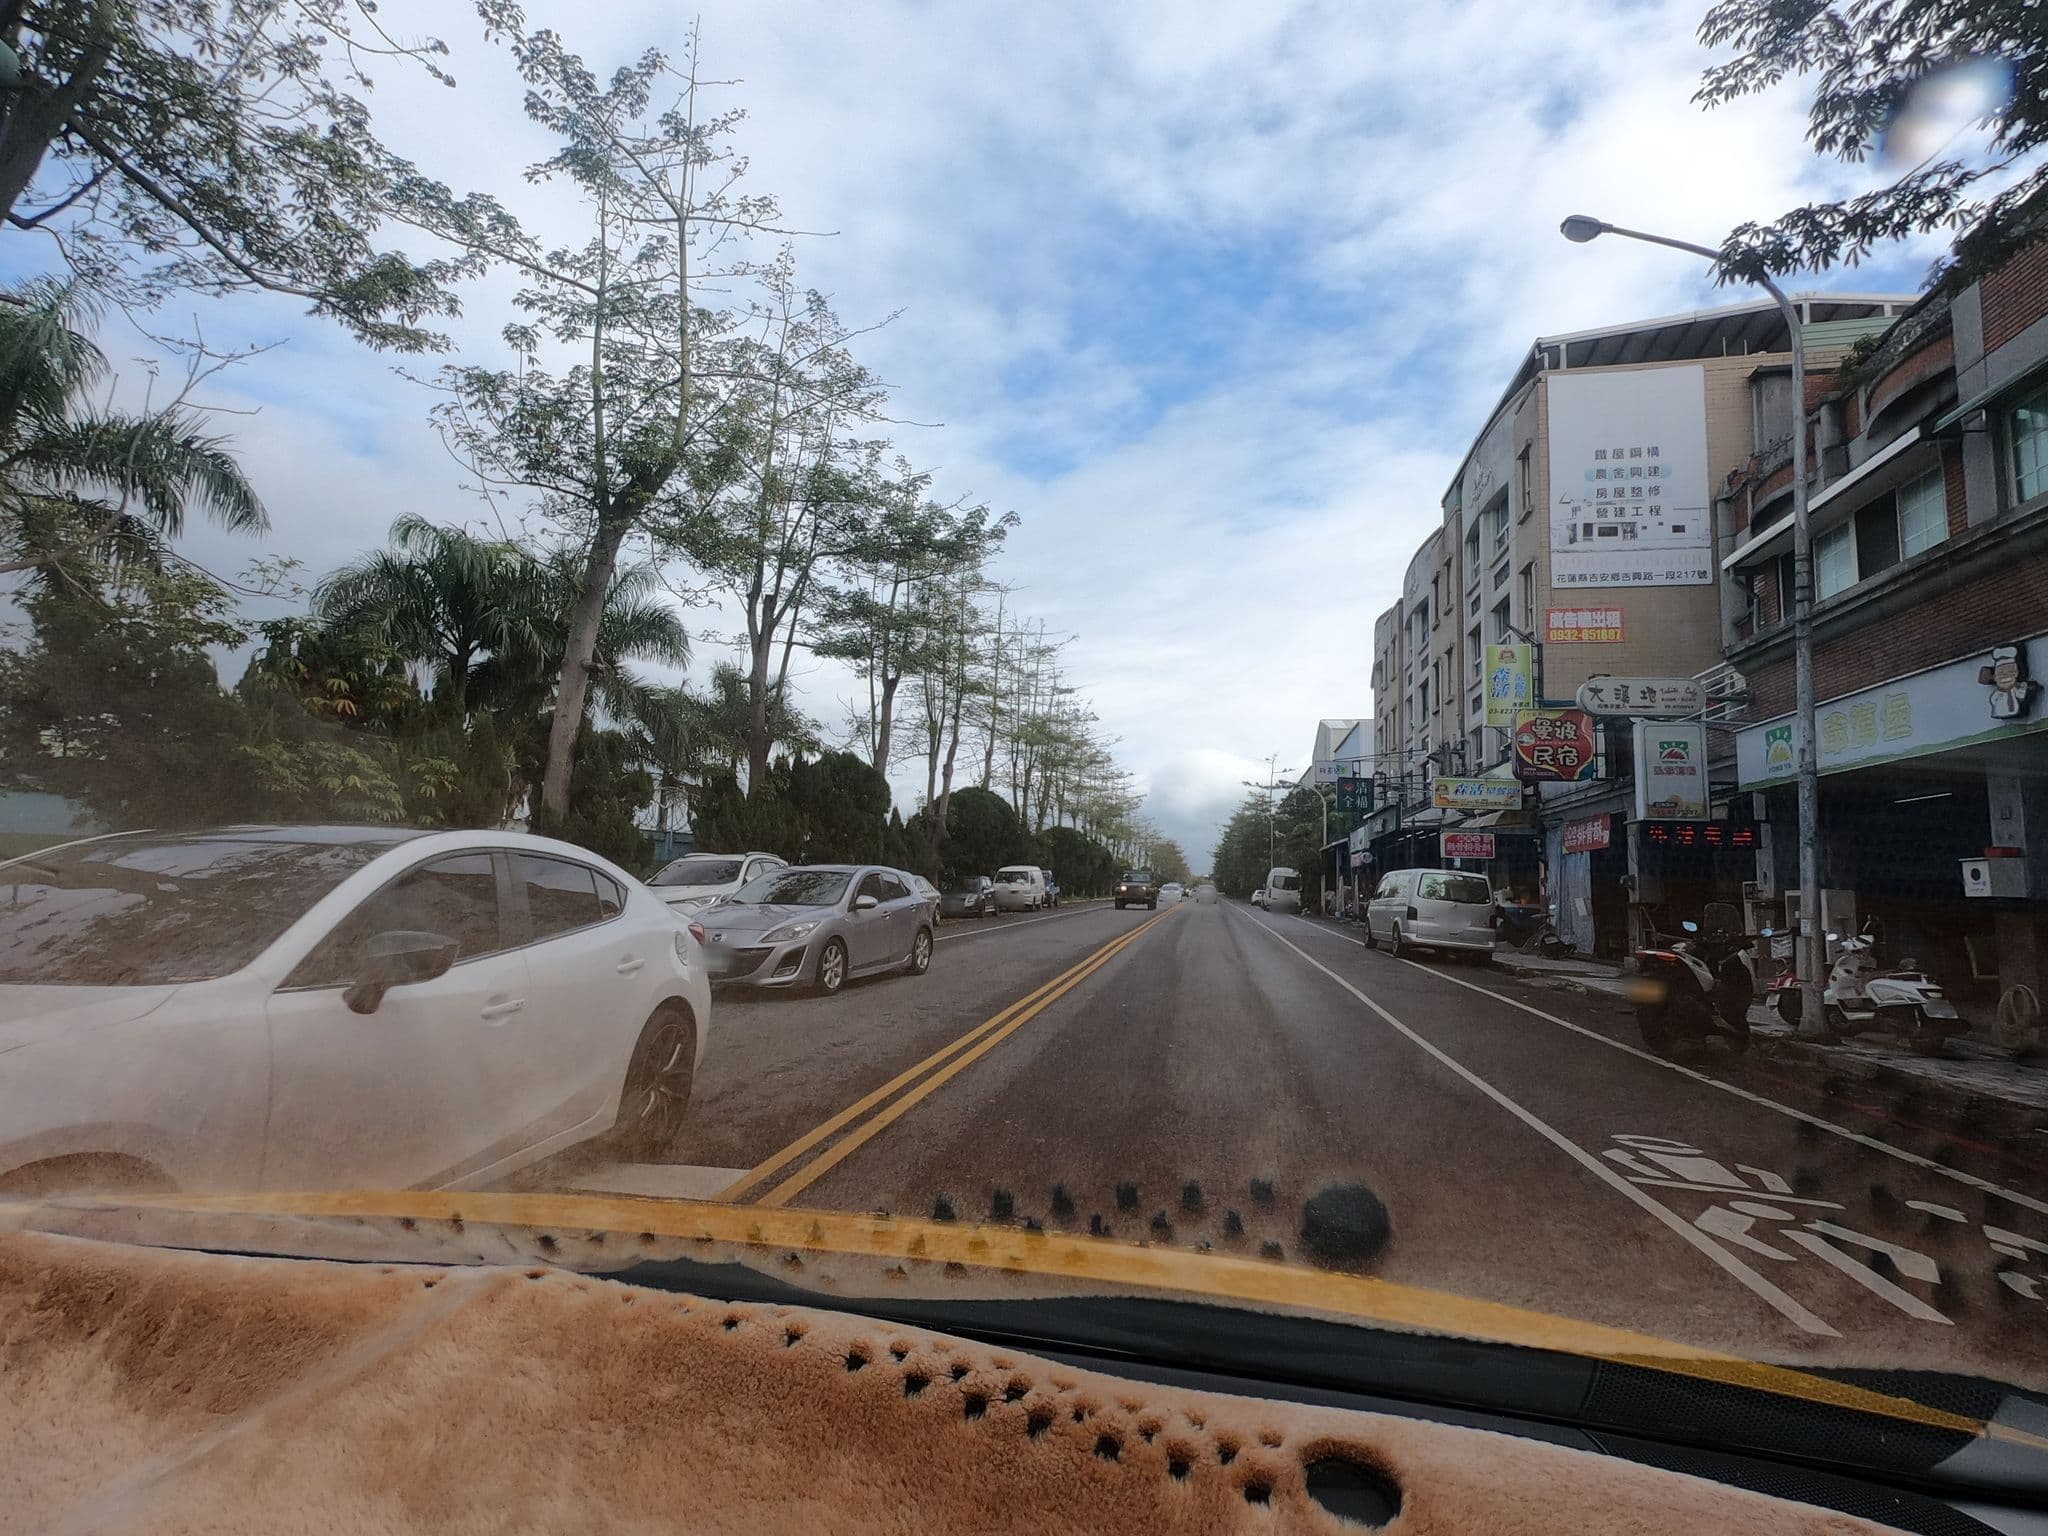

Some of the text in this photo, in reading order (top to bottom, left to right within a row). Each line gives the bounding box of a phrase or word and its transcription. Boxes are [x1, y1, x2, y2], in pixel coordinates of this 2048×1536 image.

[1594, 446, 1659, 460] 鐵屋鋼構
[1595, 466, 1660, 479] 農舍興建
[1596, 485, 1661, 498] 房屋整修
[1596, 505, 1662, 518] 營建工程
[1587, 684, 1657, 704] 大溪地
[1531, 718, 1578, 741] 曼波
[1533, 745, 1578, 766] 民宿
